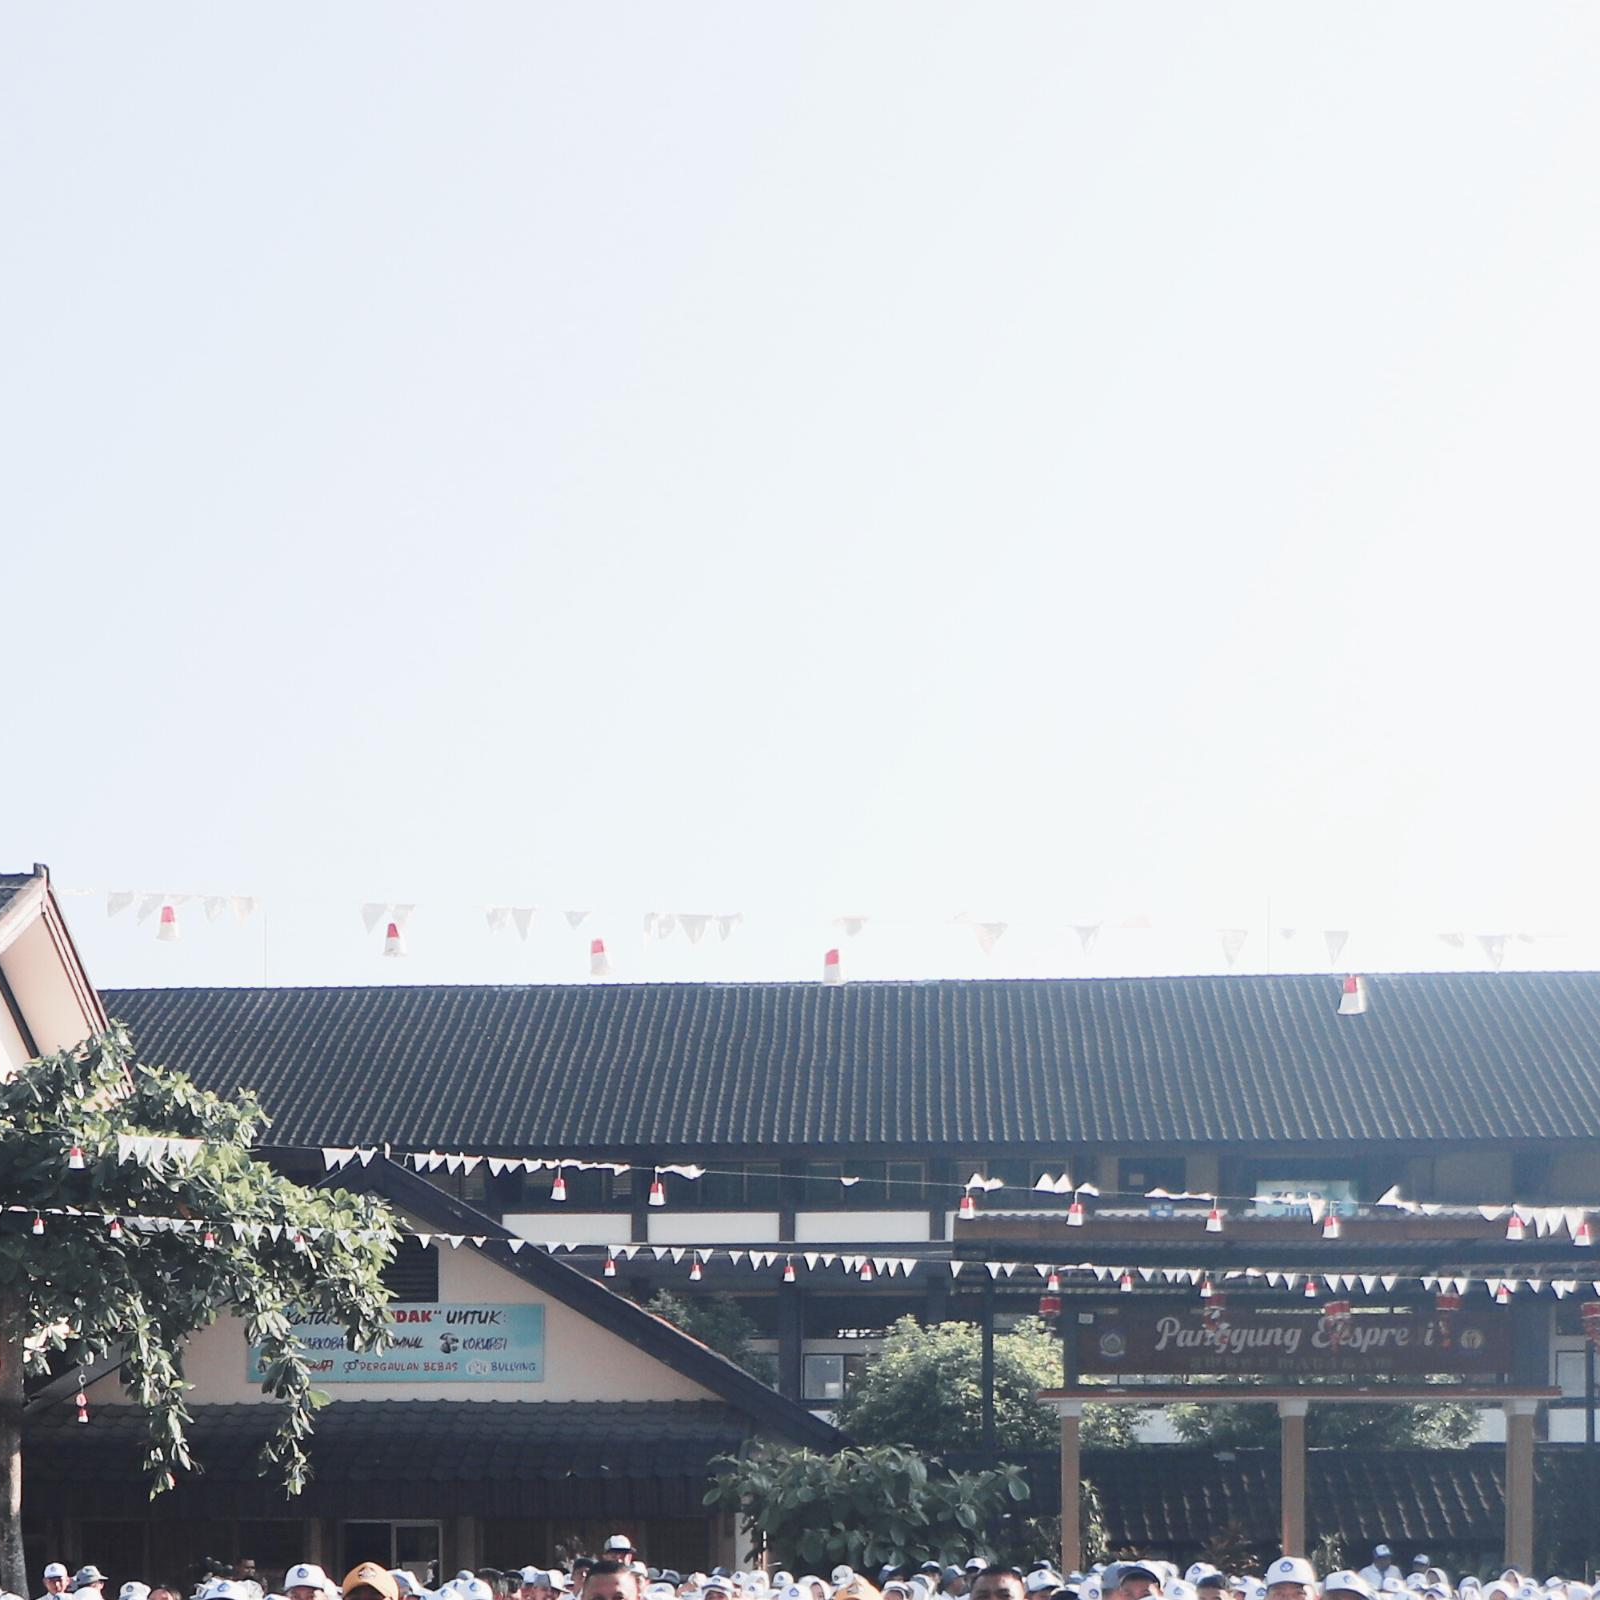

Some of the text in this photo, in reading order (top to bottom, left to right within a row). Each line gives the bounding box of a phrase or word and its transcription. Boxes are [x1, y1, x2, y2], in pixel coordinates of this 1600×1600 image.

[1154, 1316, 1434, 1355] Panggung Eksprei
[462, 1336, 508, 1351] KORUPSI
[360, 1361, 458, 1372] PERGAULAN BEBAS
[491, 1361, 536, 1372] BULLYING
